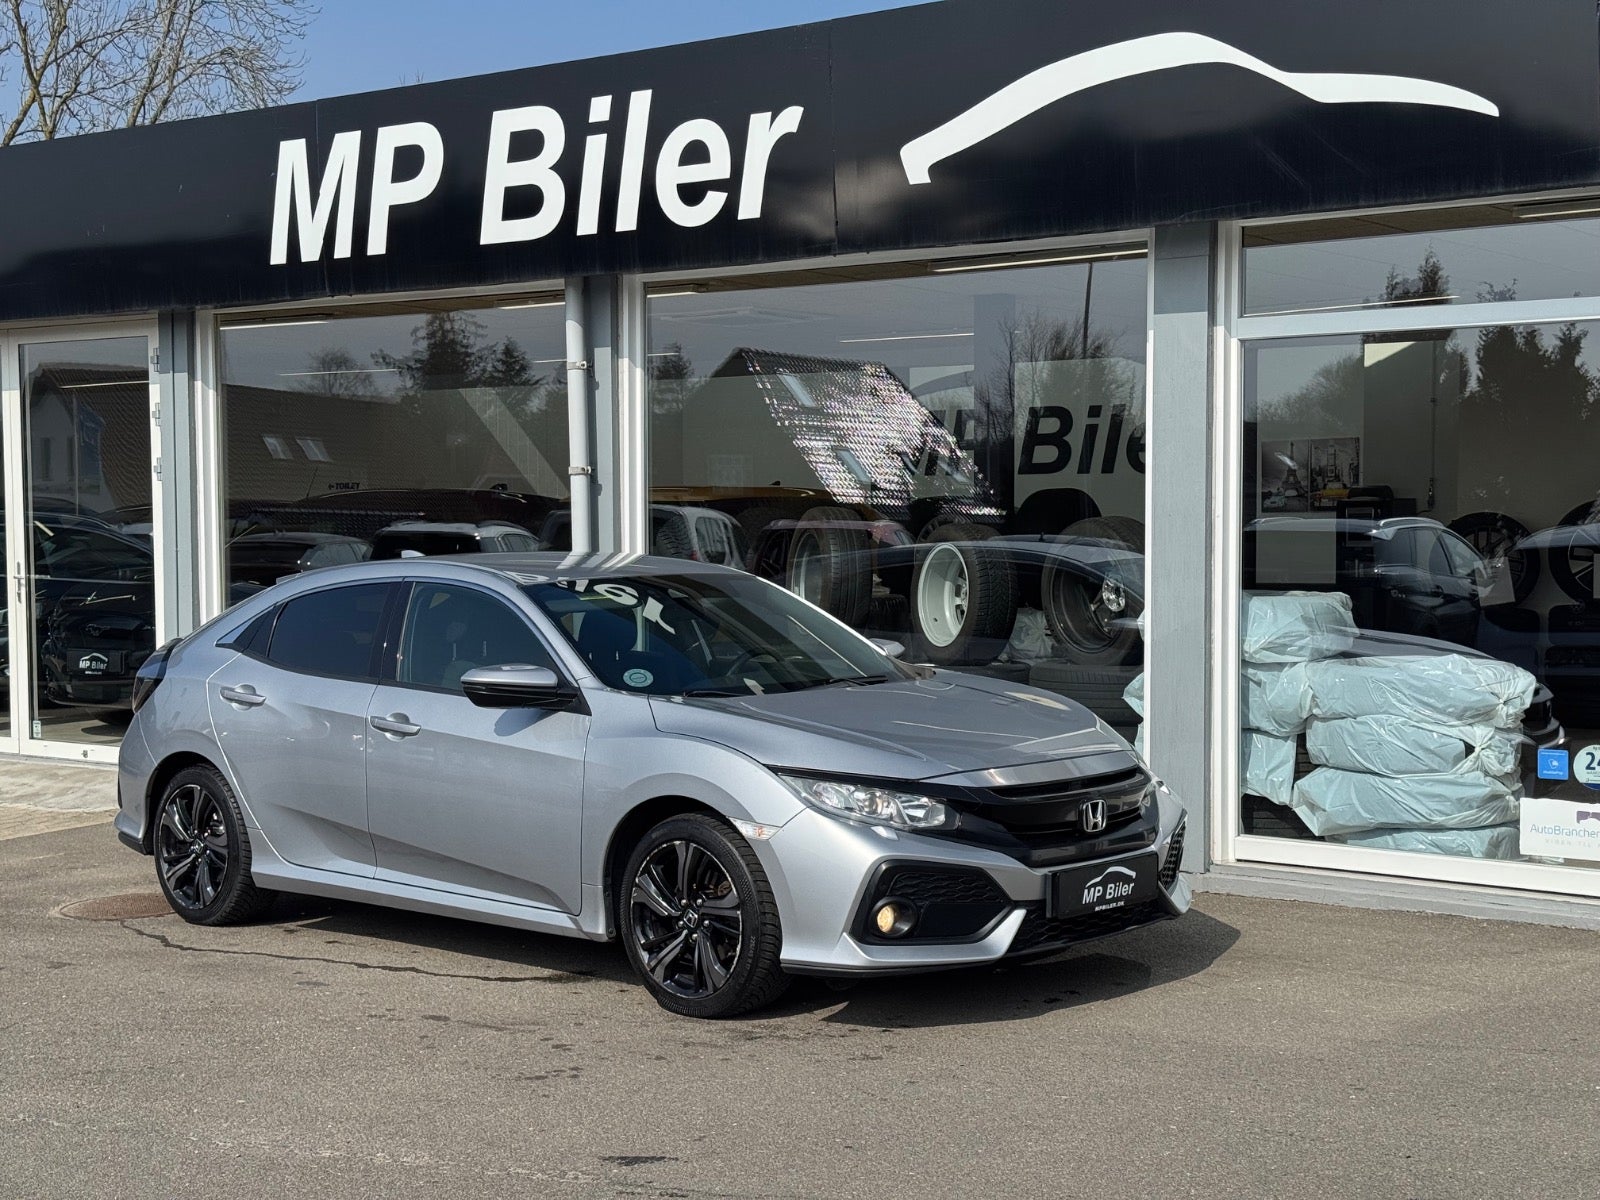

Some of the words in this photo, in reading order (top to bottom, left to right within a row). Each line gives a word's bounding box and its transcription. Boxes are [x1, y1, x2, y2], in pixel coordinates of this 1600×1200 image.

[270, 121, 444, 265] MP
[480, 89, 804, 245] Biler
[336, 482, 360, 490] TOILET
[79, 660, 90, 669] MP
[91, 661, 107, 670] Biler
[1585, 751, 1600, 771] 2
[1082, 886, 1103, 905] MP
[1105, 880, 1135, 899] Biler
